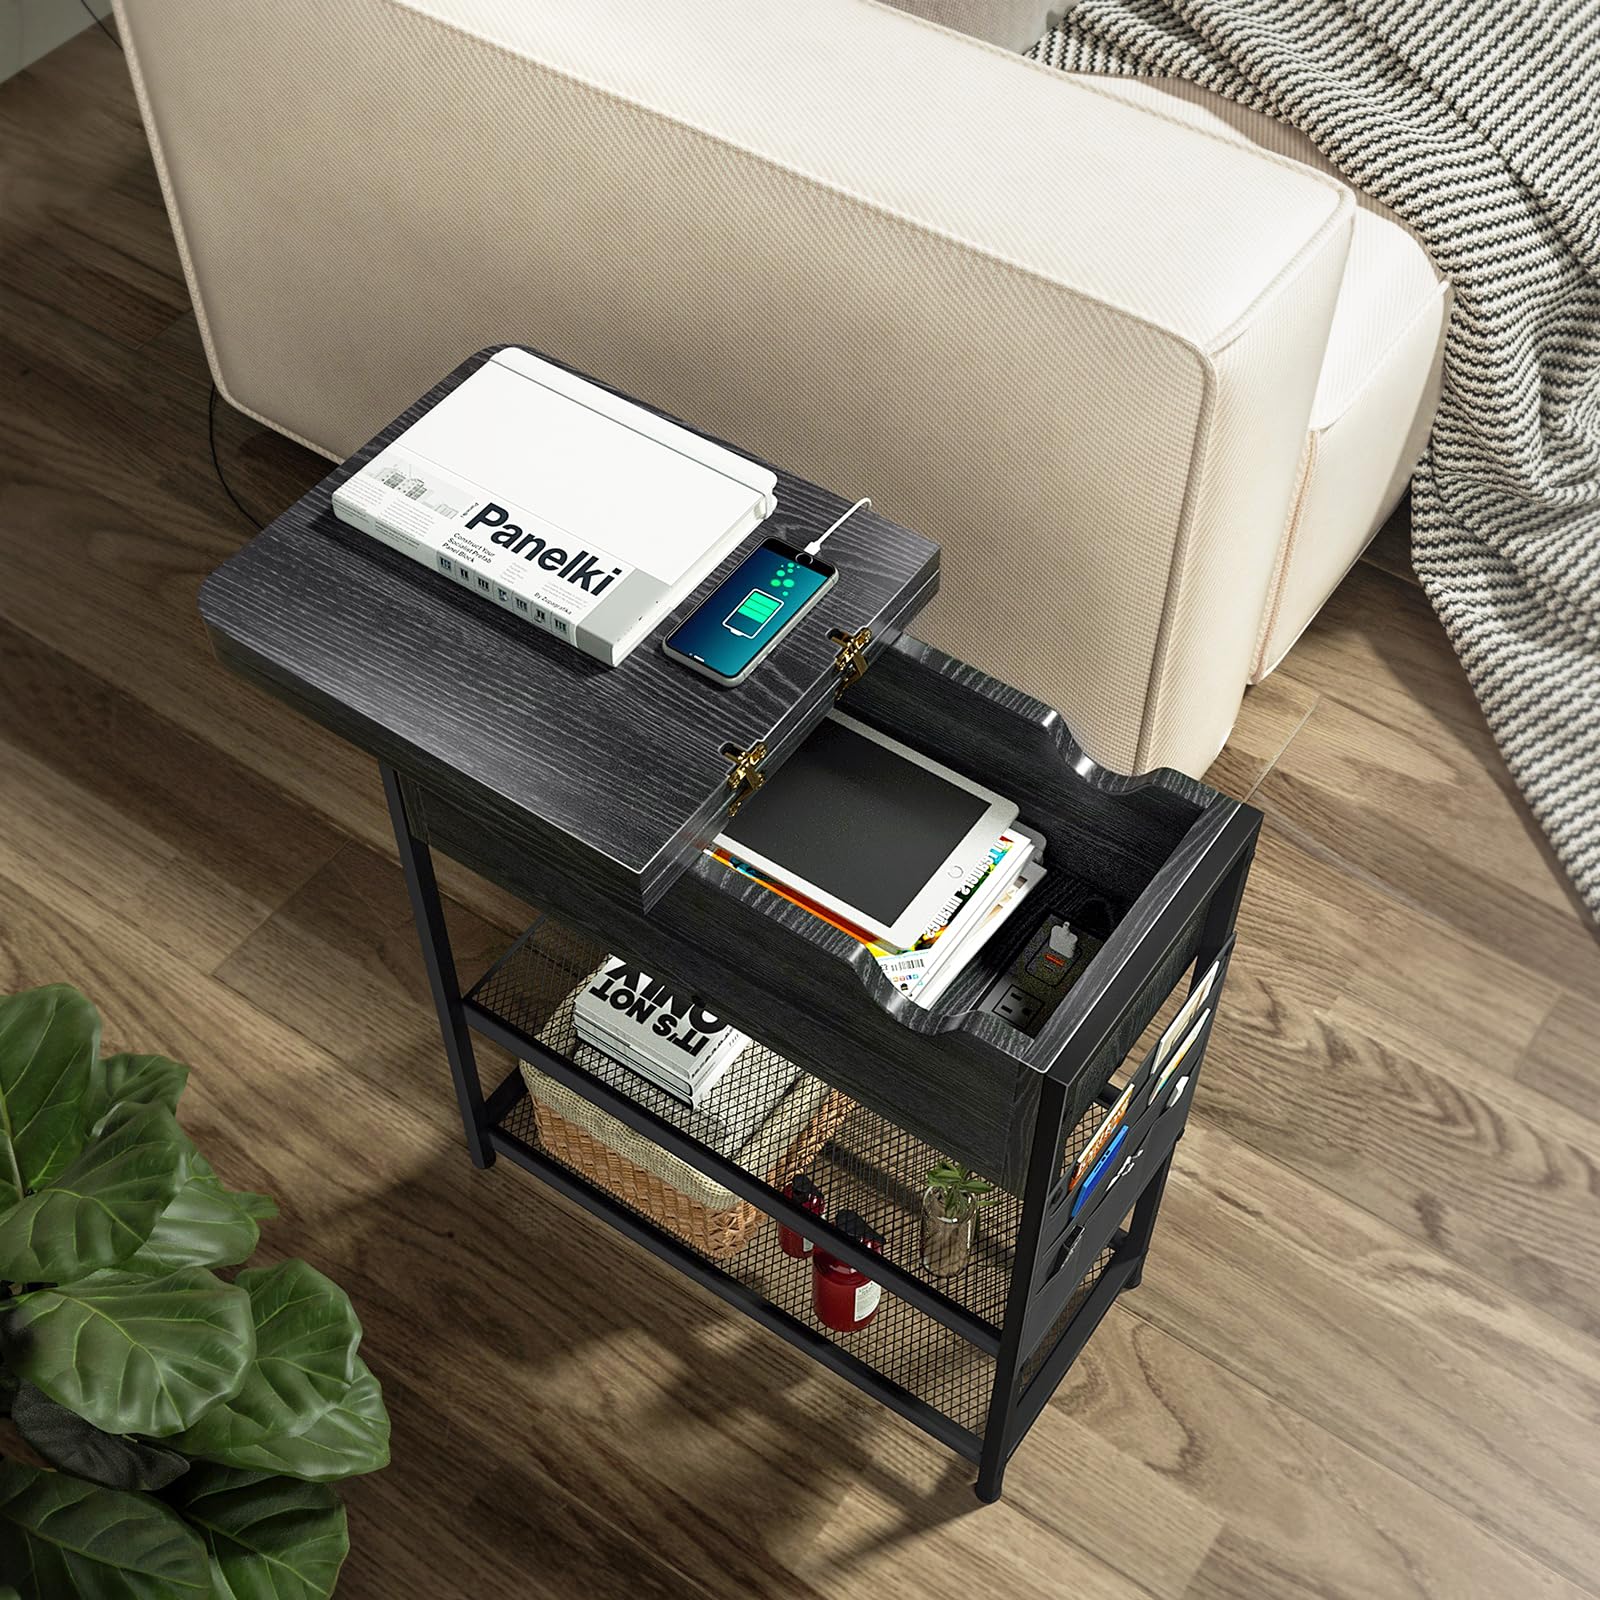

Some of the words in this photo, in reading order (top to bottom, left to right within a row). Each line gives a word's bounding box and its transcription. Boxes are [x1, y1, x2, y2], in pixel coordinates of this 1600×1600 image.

[442, 542, 460, 554] Panel
[457, 551, 475, 563] Block
[447, 537, 473, 554] Socialist
[471, 550, 492, 564] Prefab
[453, 532, 482, 551] Construct
[482, 547, 495, 557] Your
[464, 502, 622, 597] Panelki
[588, 978, 657, 1025] NOT
[651, 1013, 710, 1058] IT'S
